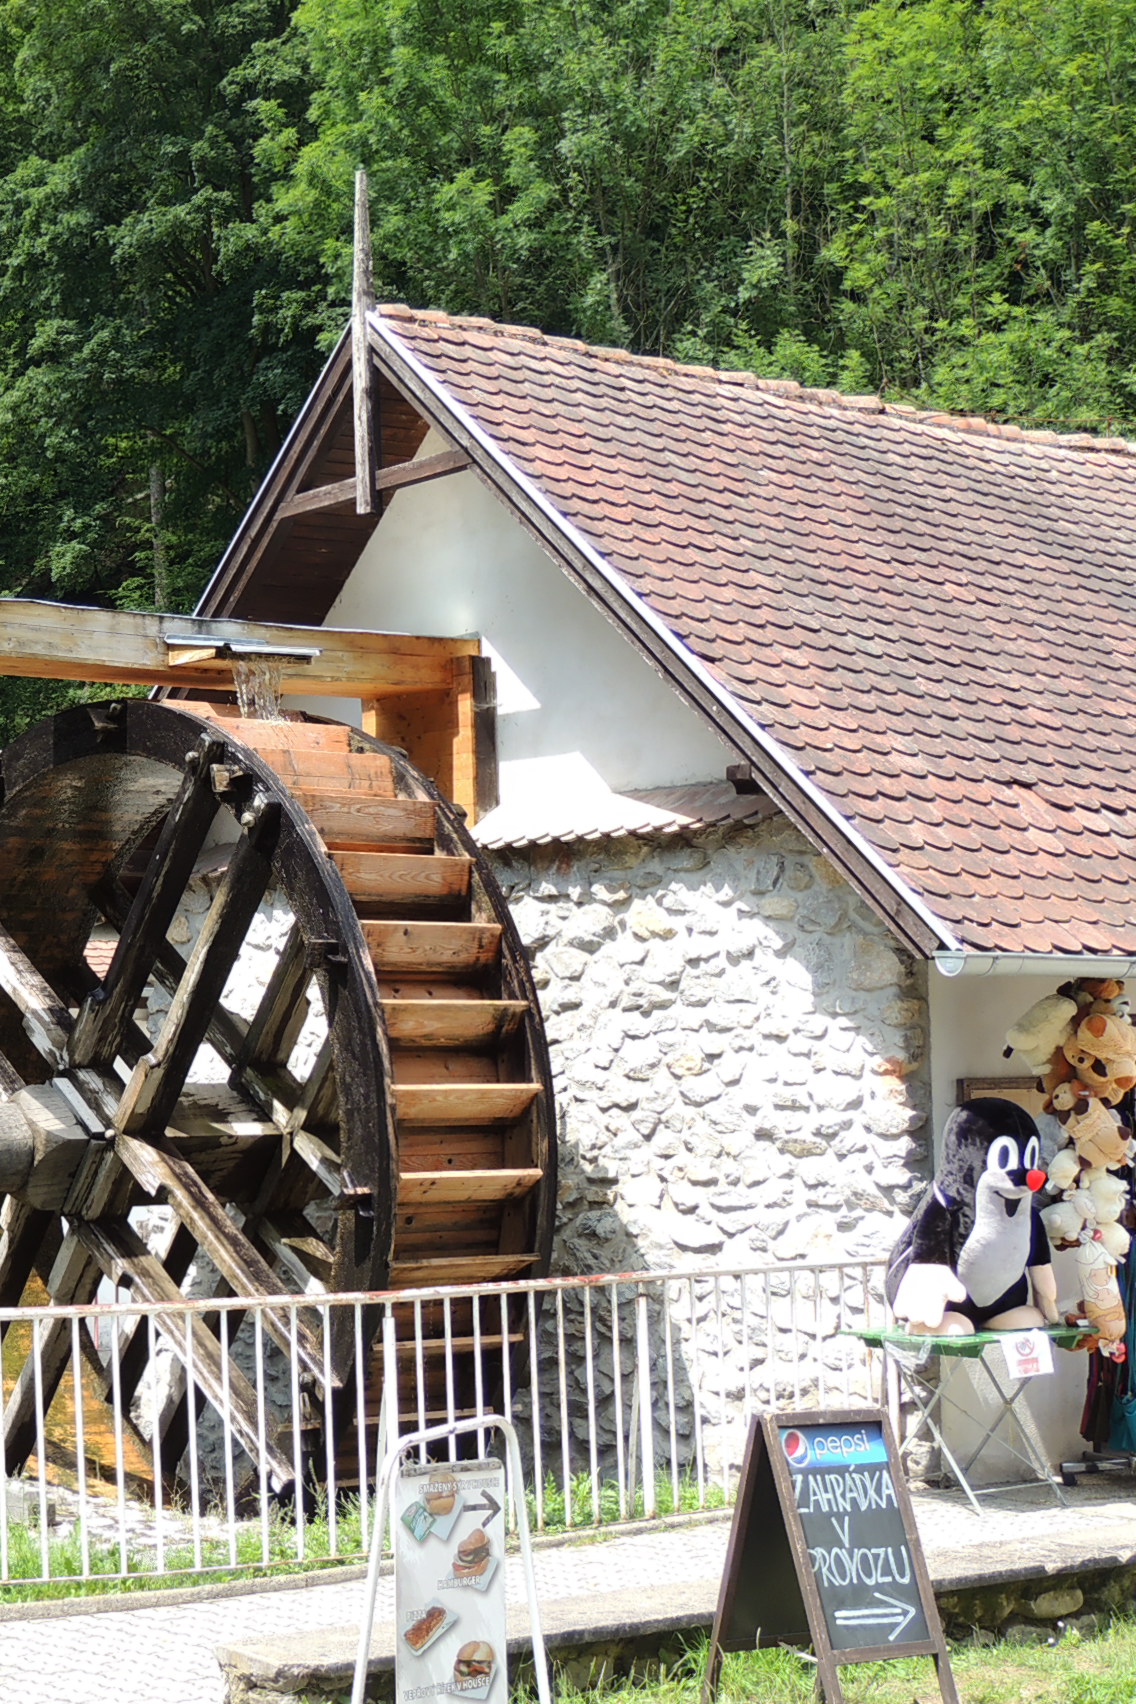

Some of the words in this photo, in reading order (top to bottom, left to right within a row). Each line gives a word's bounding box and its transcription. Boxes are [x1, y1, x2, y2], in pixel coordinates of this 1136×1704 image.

[813, 1430, 871, 1459] pepsi
[791, 1465, 899, 1514] ZAHRÁDKA
[831, 1515, 850, 1548] V
[807, 1545, 911, 1588] PROVOZU
[437, 1576, 481, 1590] HAMBURGER
[462, 1677, 490, 1690] HOUSCE
